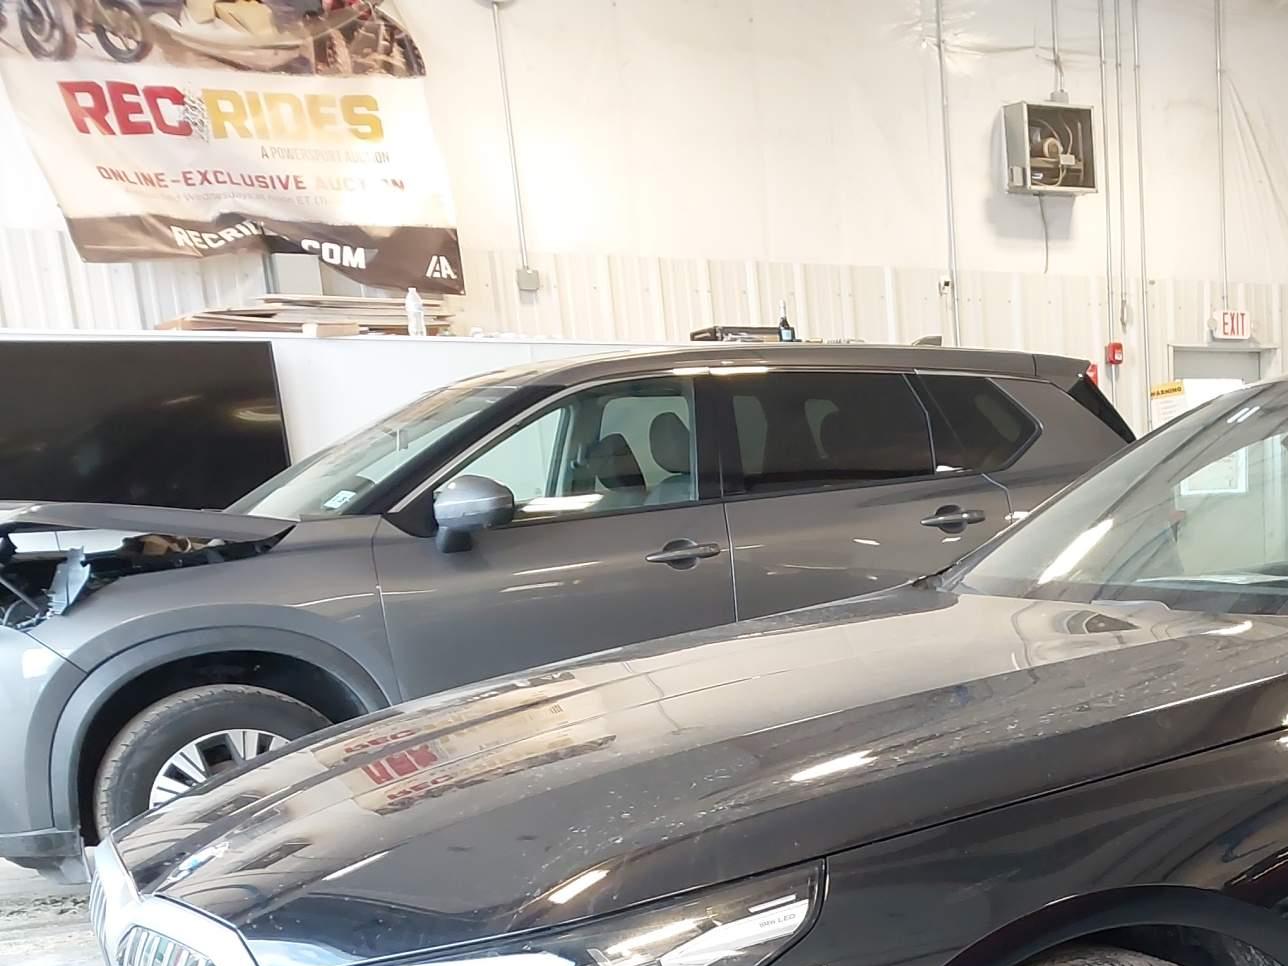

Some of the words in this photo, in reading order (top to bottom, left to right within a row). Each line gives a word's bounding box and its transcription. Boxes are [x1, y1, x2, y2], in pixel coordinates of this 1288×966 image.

[58, 81, 193, 137] REC
[202, 88, 384, 142] RIDES
[345, 150, 391, 165] AUCON
[96, 165, 307, 191] ONLINE-EXCLUSIVE
[315, 175, 406, 193] AUCTN
[1222, 311, 1246, 337] EXIT
